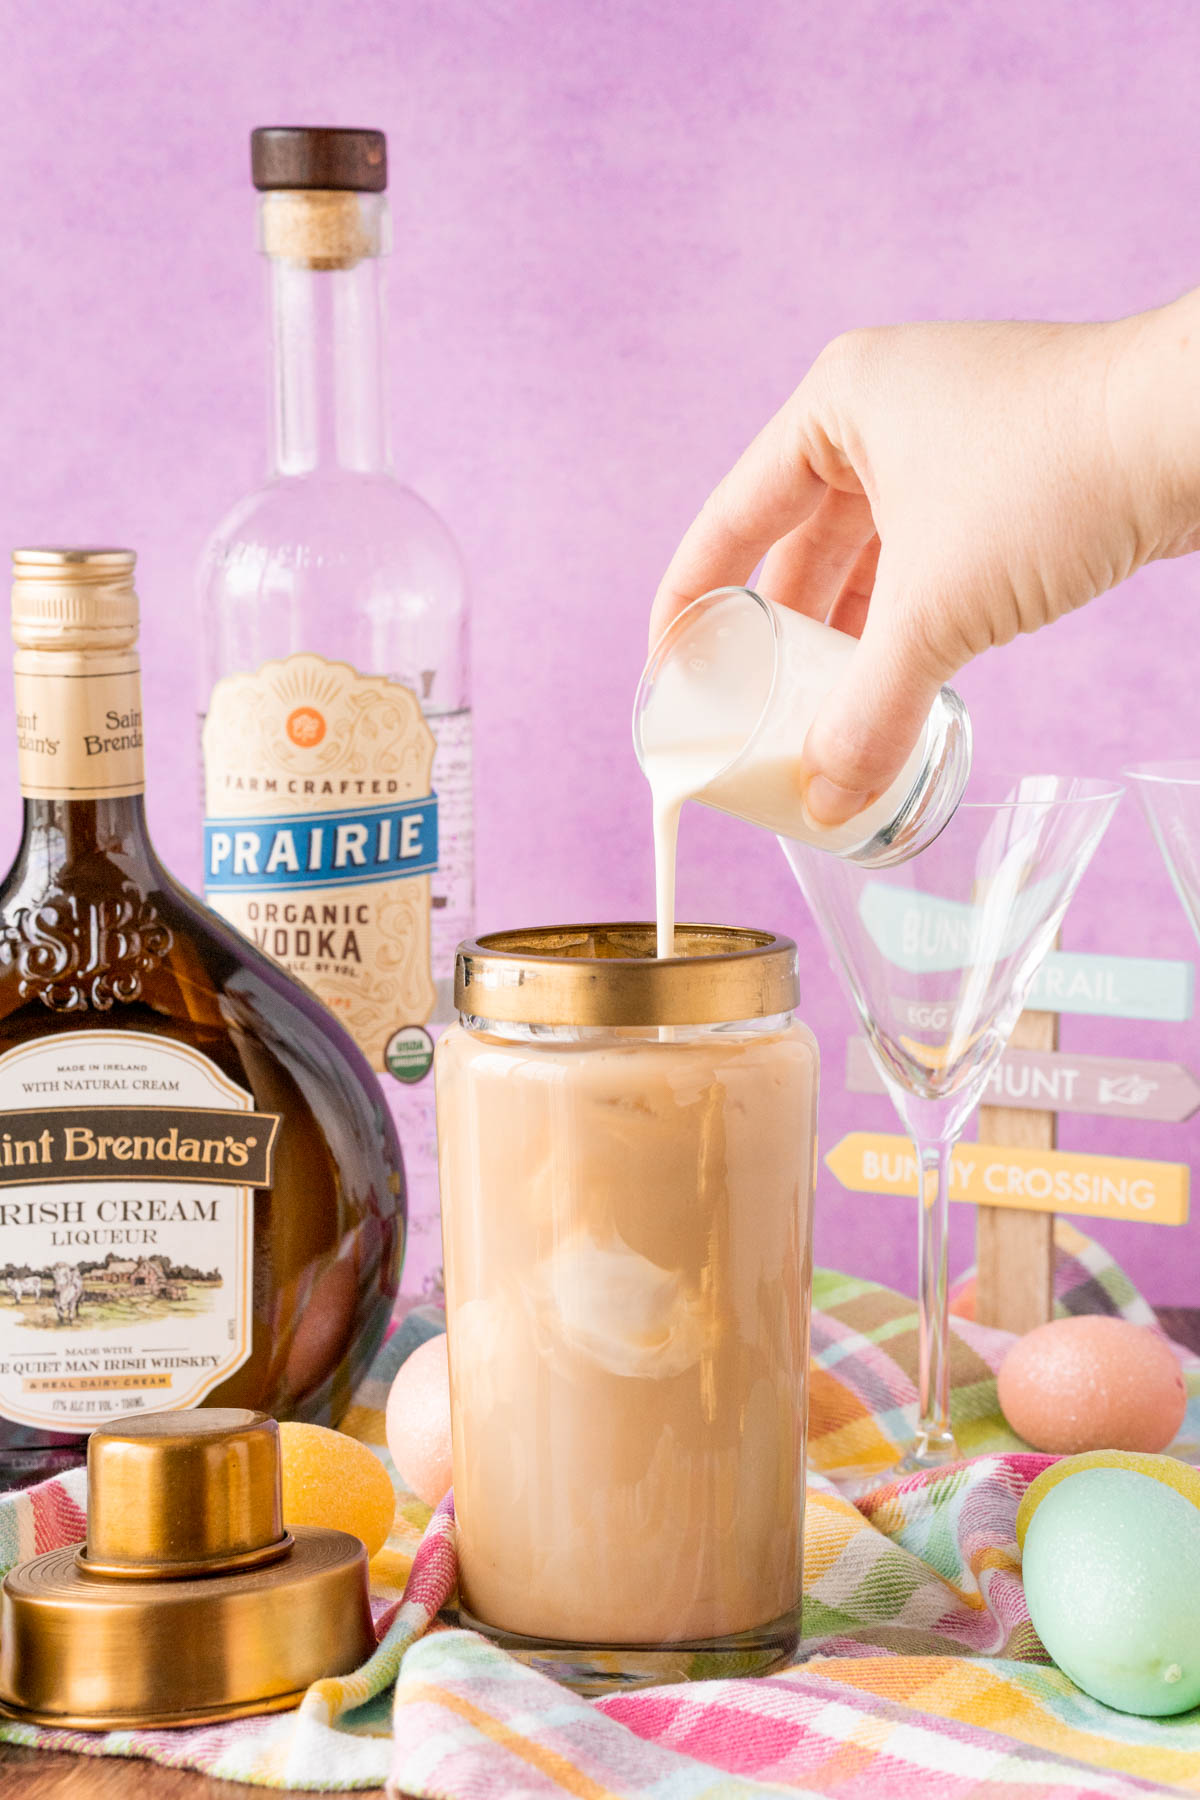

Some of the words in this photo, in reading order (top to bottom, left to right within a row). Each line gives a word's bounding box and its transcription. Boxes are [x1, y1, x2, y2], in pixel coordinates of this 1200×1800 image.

[288, 779, 398, 795] CRAFTED
[210, 813, 425, 876] PRAIRIE
[248, 902, 370, 924] ORGANIC
[254, 927, 362, 963] VODKA
[907, 1006, 948, 1030] EGG
[57, 1065, 85, 1073] MADE
[103, 1063, 148, 1072] IRELAND
[22, 1081, 59, 1093] WITH
[63, 1079, 128, 1091] NATURAL
[132, 1079, 180, 1091] CREAM
[0, 1128, 55, 1168] int
[983, 1163, 1156, 1211] CROSSING
[0, 1200, 86, 1226] RISH
[97, 1199, 220, 1222] CREAM
[51, 1229, 158, 1247] LIQUEUR
[65, 1347, 100, 1357] MADE
[102, 1346, 133, 1355] WITH
[13, 1361, 61, 1376] QUIET
[65, 1360, 99, 1373] MAN
[104, 1358, 147, 1371] IRISH
[151, 1355, 220, 1369] WHISKEY
[41, 1380, 76, 1390] REAL
[80, 1379, 119, 1389] DAIRY
[123, 1377, 167, 1387] CREAM
